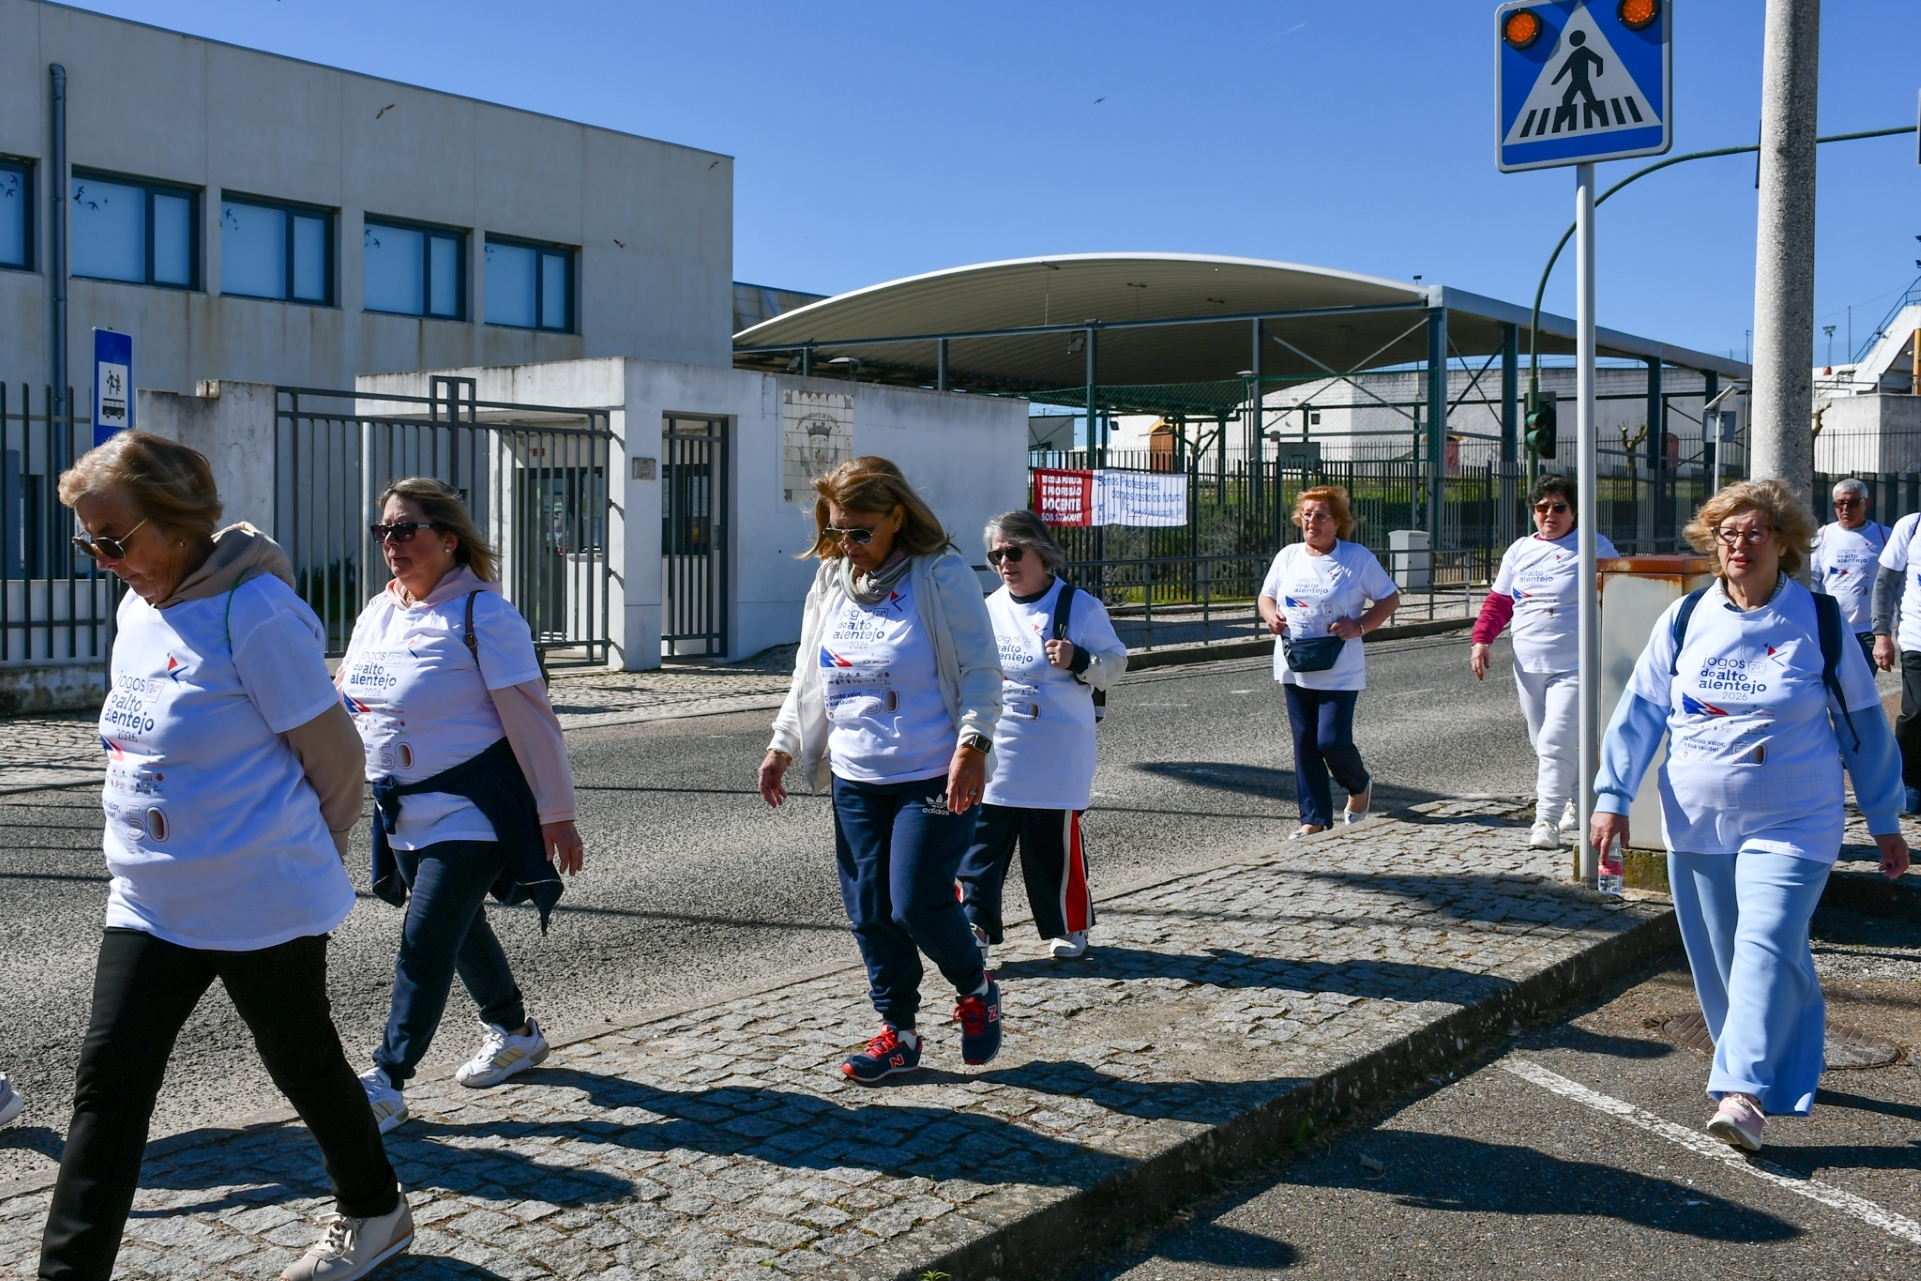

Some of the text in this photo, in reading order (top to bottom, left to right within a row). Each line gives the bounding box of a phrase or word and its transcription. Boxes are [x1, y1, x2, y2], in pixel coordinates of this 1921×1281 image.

[1042, 498, 1081, 512] DOCENTE
[832, 628, 885, 642] alentejo
[849, 641, 869, 649] 2026
[358, 648, 386, 662] jogos
[1000, 652, 1034, 664] entejo
[1701, 654, 1746, 669] jogos
[362, 662, 385, 675] alto
[1716, 669, 1748, 681] alto
[350, 673, 397, 690] alentejo
[1698, 679, 1767, 694] alentejo
[364, 687, 382, 697] 2026
[1722, 691, 1748, 701] 2026
[116, 693, 142, 712] alto
[117, 728, 138, 742] 2026
[1707, 739, 1726, 748] valor,
[922, 807, 950, 816] adidas
